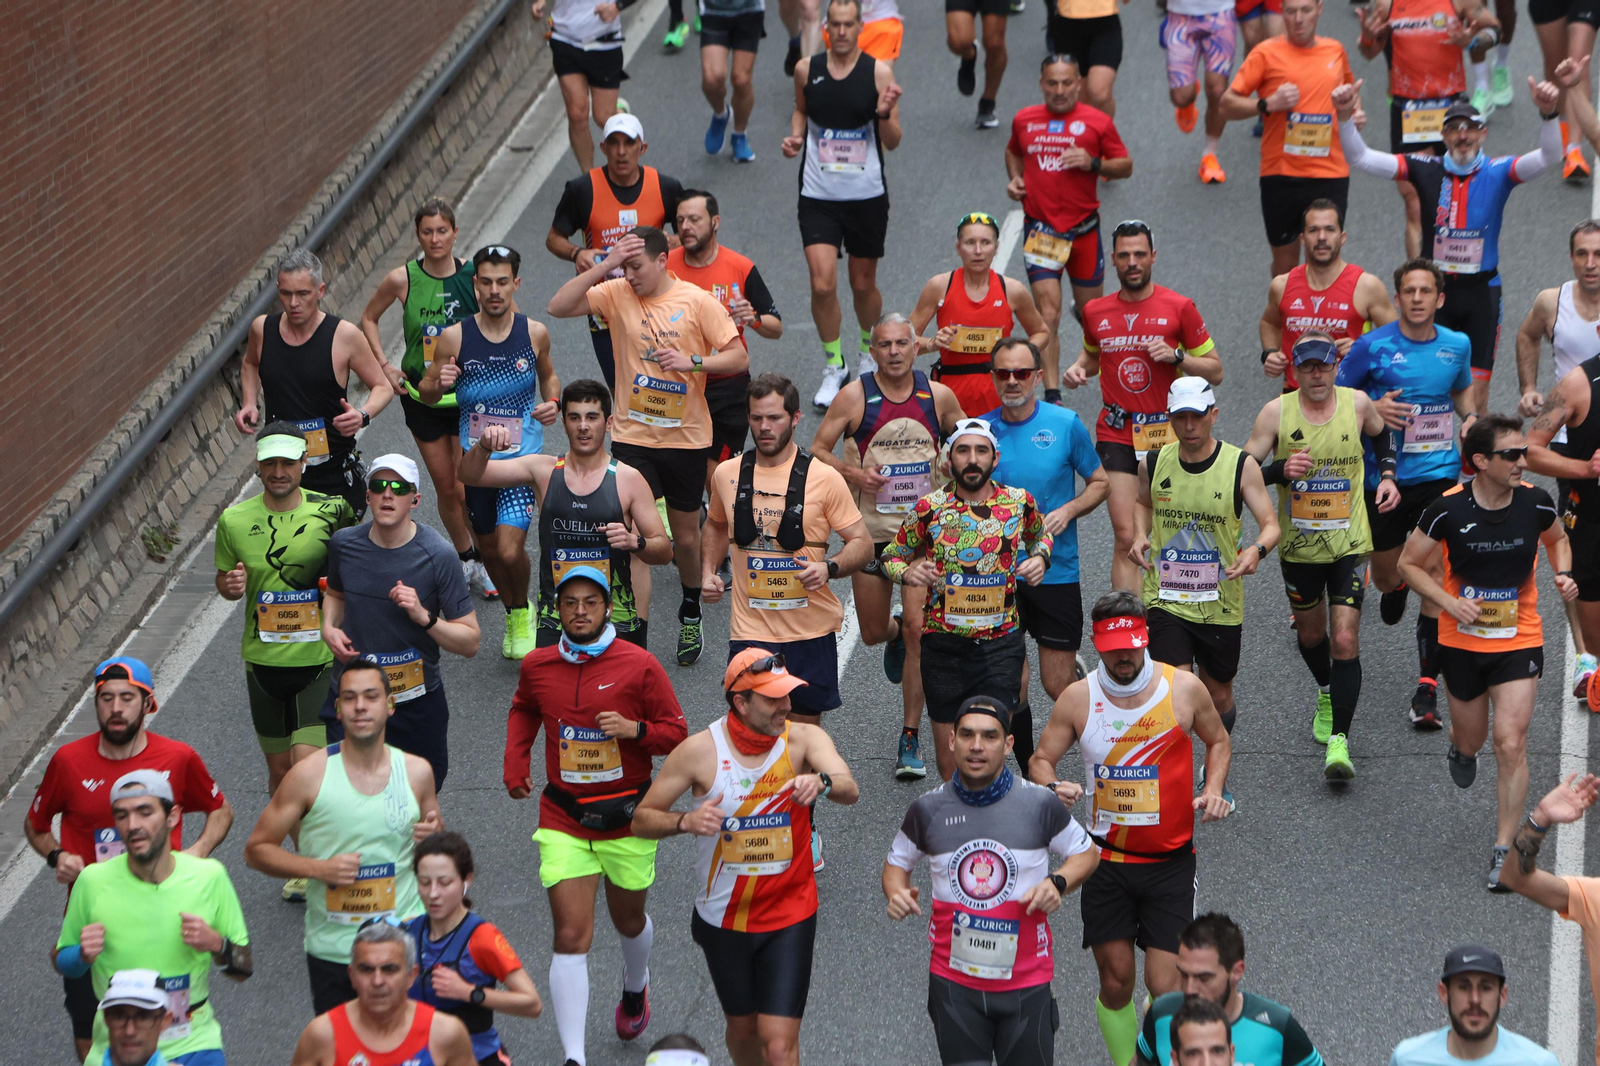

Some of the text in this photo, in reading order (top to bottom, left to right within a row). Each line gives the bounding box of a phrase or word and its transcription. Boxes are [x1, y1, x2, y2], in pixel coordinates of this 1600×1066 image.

[836, 131, 862, 139] ZURICH
[602, 226, 625, 237] CAMPO
[1451, 229, 1480, 237] ZURICH
[966, 333, 985, 342] 4853
[650, 380, 681, 392] ZURICH
[647, 395, 666, 406] 5265
[488, 407, 518, 416] ZURICH
[644, 406, 666, 417] ISMAEL
[1424, 403, 1450, 414] ZURICH
[297, 421, 319, 430] RICH
[1148, 429, 1167, 439] 6073
[1415, 433, 1445, 441] CARAMELO
[1030, 435, 1057, 443] PORTACELI
[1317, 455, 1359, 467] PIRÁMIDE
[894, 465, 925, 474] ZURICH
[894, 482, 914, 490] 6563
[1311, 481, 1344, 491] ZURICH
[891, 494, 919, 503] ANTONIO
[1310, 498, 1331, 507] 6096
[763, 507, 784, 515] Sevill
[1162, 520, 1216, 534] MIRAFLORES
[1466, 538, 1524, 550] TRIALS
[569, 551, 602, 559] ZURICH
[1180, 552, 1213, 561] ZURICH
[767, 560, 800, 569] ZURIC
[1179, 569, 1200, 578] 7470
[767, 577, 788, 586] 5463
[966, 576, 1000, 586] ZURICH
[1160, 581, 1218, 590] CORDOBÉS ACEDO
[277, 592, 312, 602] ZURICH
[771, 591, 785, 599] LUC
[966, 594, 986, 603] 4834
[1478, 591, 1511, 600] ZURICH
[278, 610, 299, 619] 6058
[949, 606, 1001, 615] CARLOS&PABLO
[381, 651, 415, 664] ZURICH
[1137, 716, 1156, 730] life
[577, 730, 606, 740] ZURIC
[1109, 734, 1151, 746] running
[578, 749, 600, 758] 3769
[576, 763, 604, 771] STEVEN
[1113, 768, 1150, 778] ZURICH
[762, 773, 779, 787] life
[738, 790, 774, 802] running
[1113, 788, 1136, 798] 5693
[1118, 804, 1133, 812] EDU
[744, 816, 783, 828] ZURICH
[745, 838, 769, 848] 5680
[742, 853, 774, 862] JORGITO
[358, 866, 388, 878] URICH
[348, 887, 373, 898] 3708
[974, 918, 1012, 932] ZURICH
[968, 937, 997, 951] 10481
[1036, 922, 1049, 958] RETT
